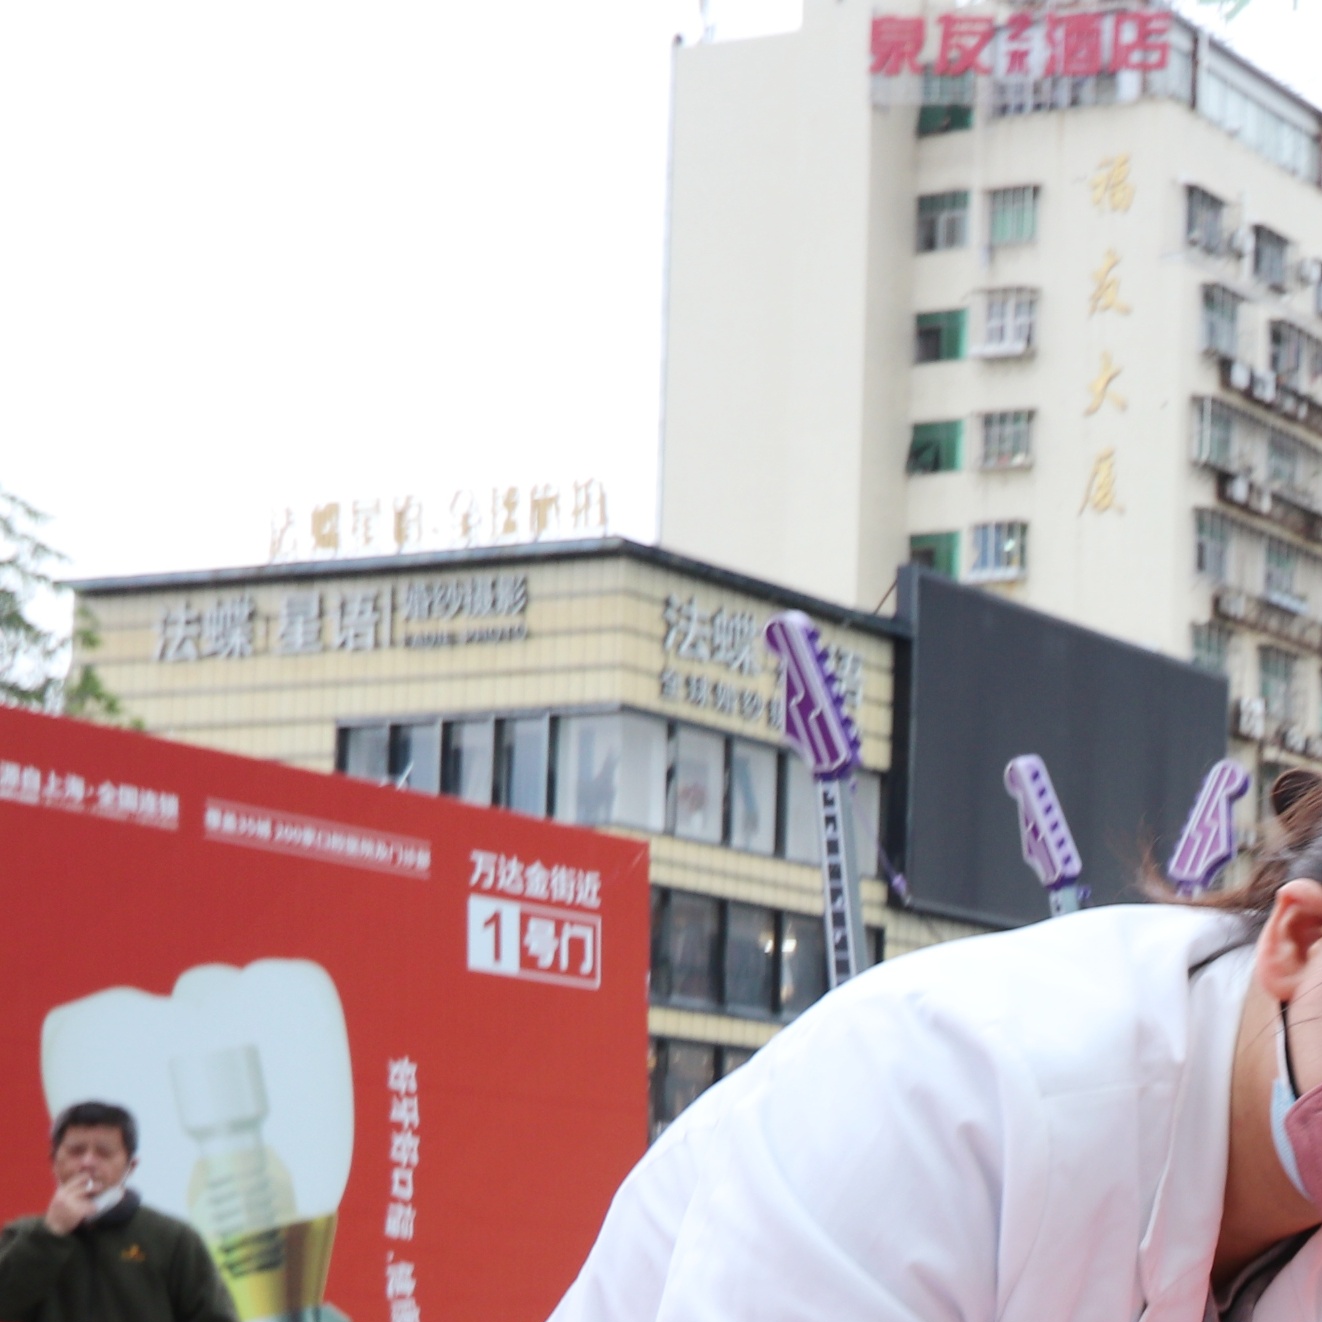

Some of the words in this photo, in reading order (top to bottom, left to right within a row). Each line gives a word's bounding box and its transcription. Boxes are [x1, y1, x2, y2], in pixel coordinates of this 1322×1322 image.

[469, 848, 602, 911] 万达金街近
[482, 908, 595, 977] 1号门
